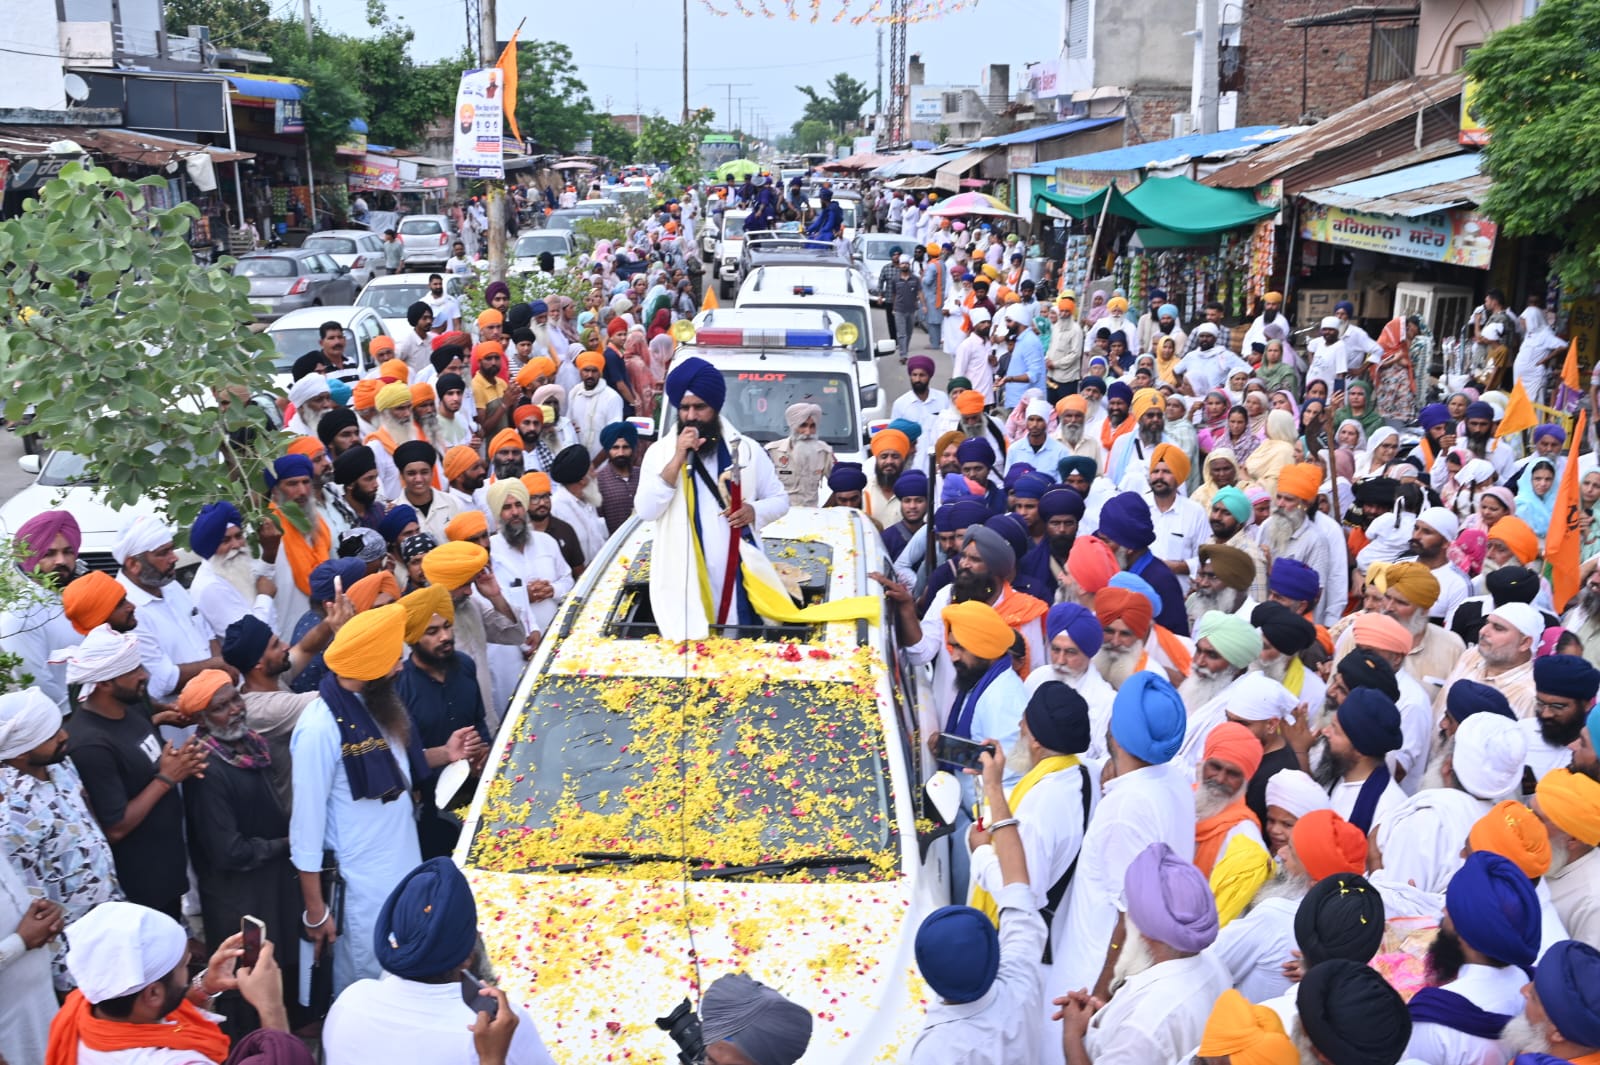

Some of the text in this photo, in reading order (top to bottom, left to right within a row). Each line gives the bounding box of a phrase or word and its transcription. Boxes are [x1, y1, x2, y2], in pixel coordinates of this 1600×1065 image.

[1332, 217, 1401, 240] ਕਰਿਆਨਾ
[1409, 227, 1446, 247] ਸਟੋਰ
[738, 373, 786, 382] PILOT
